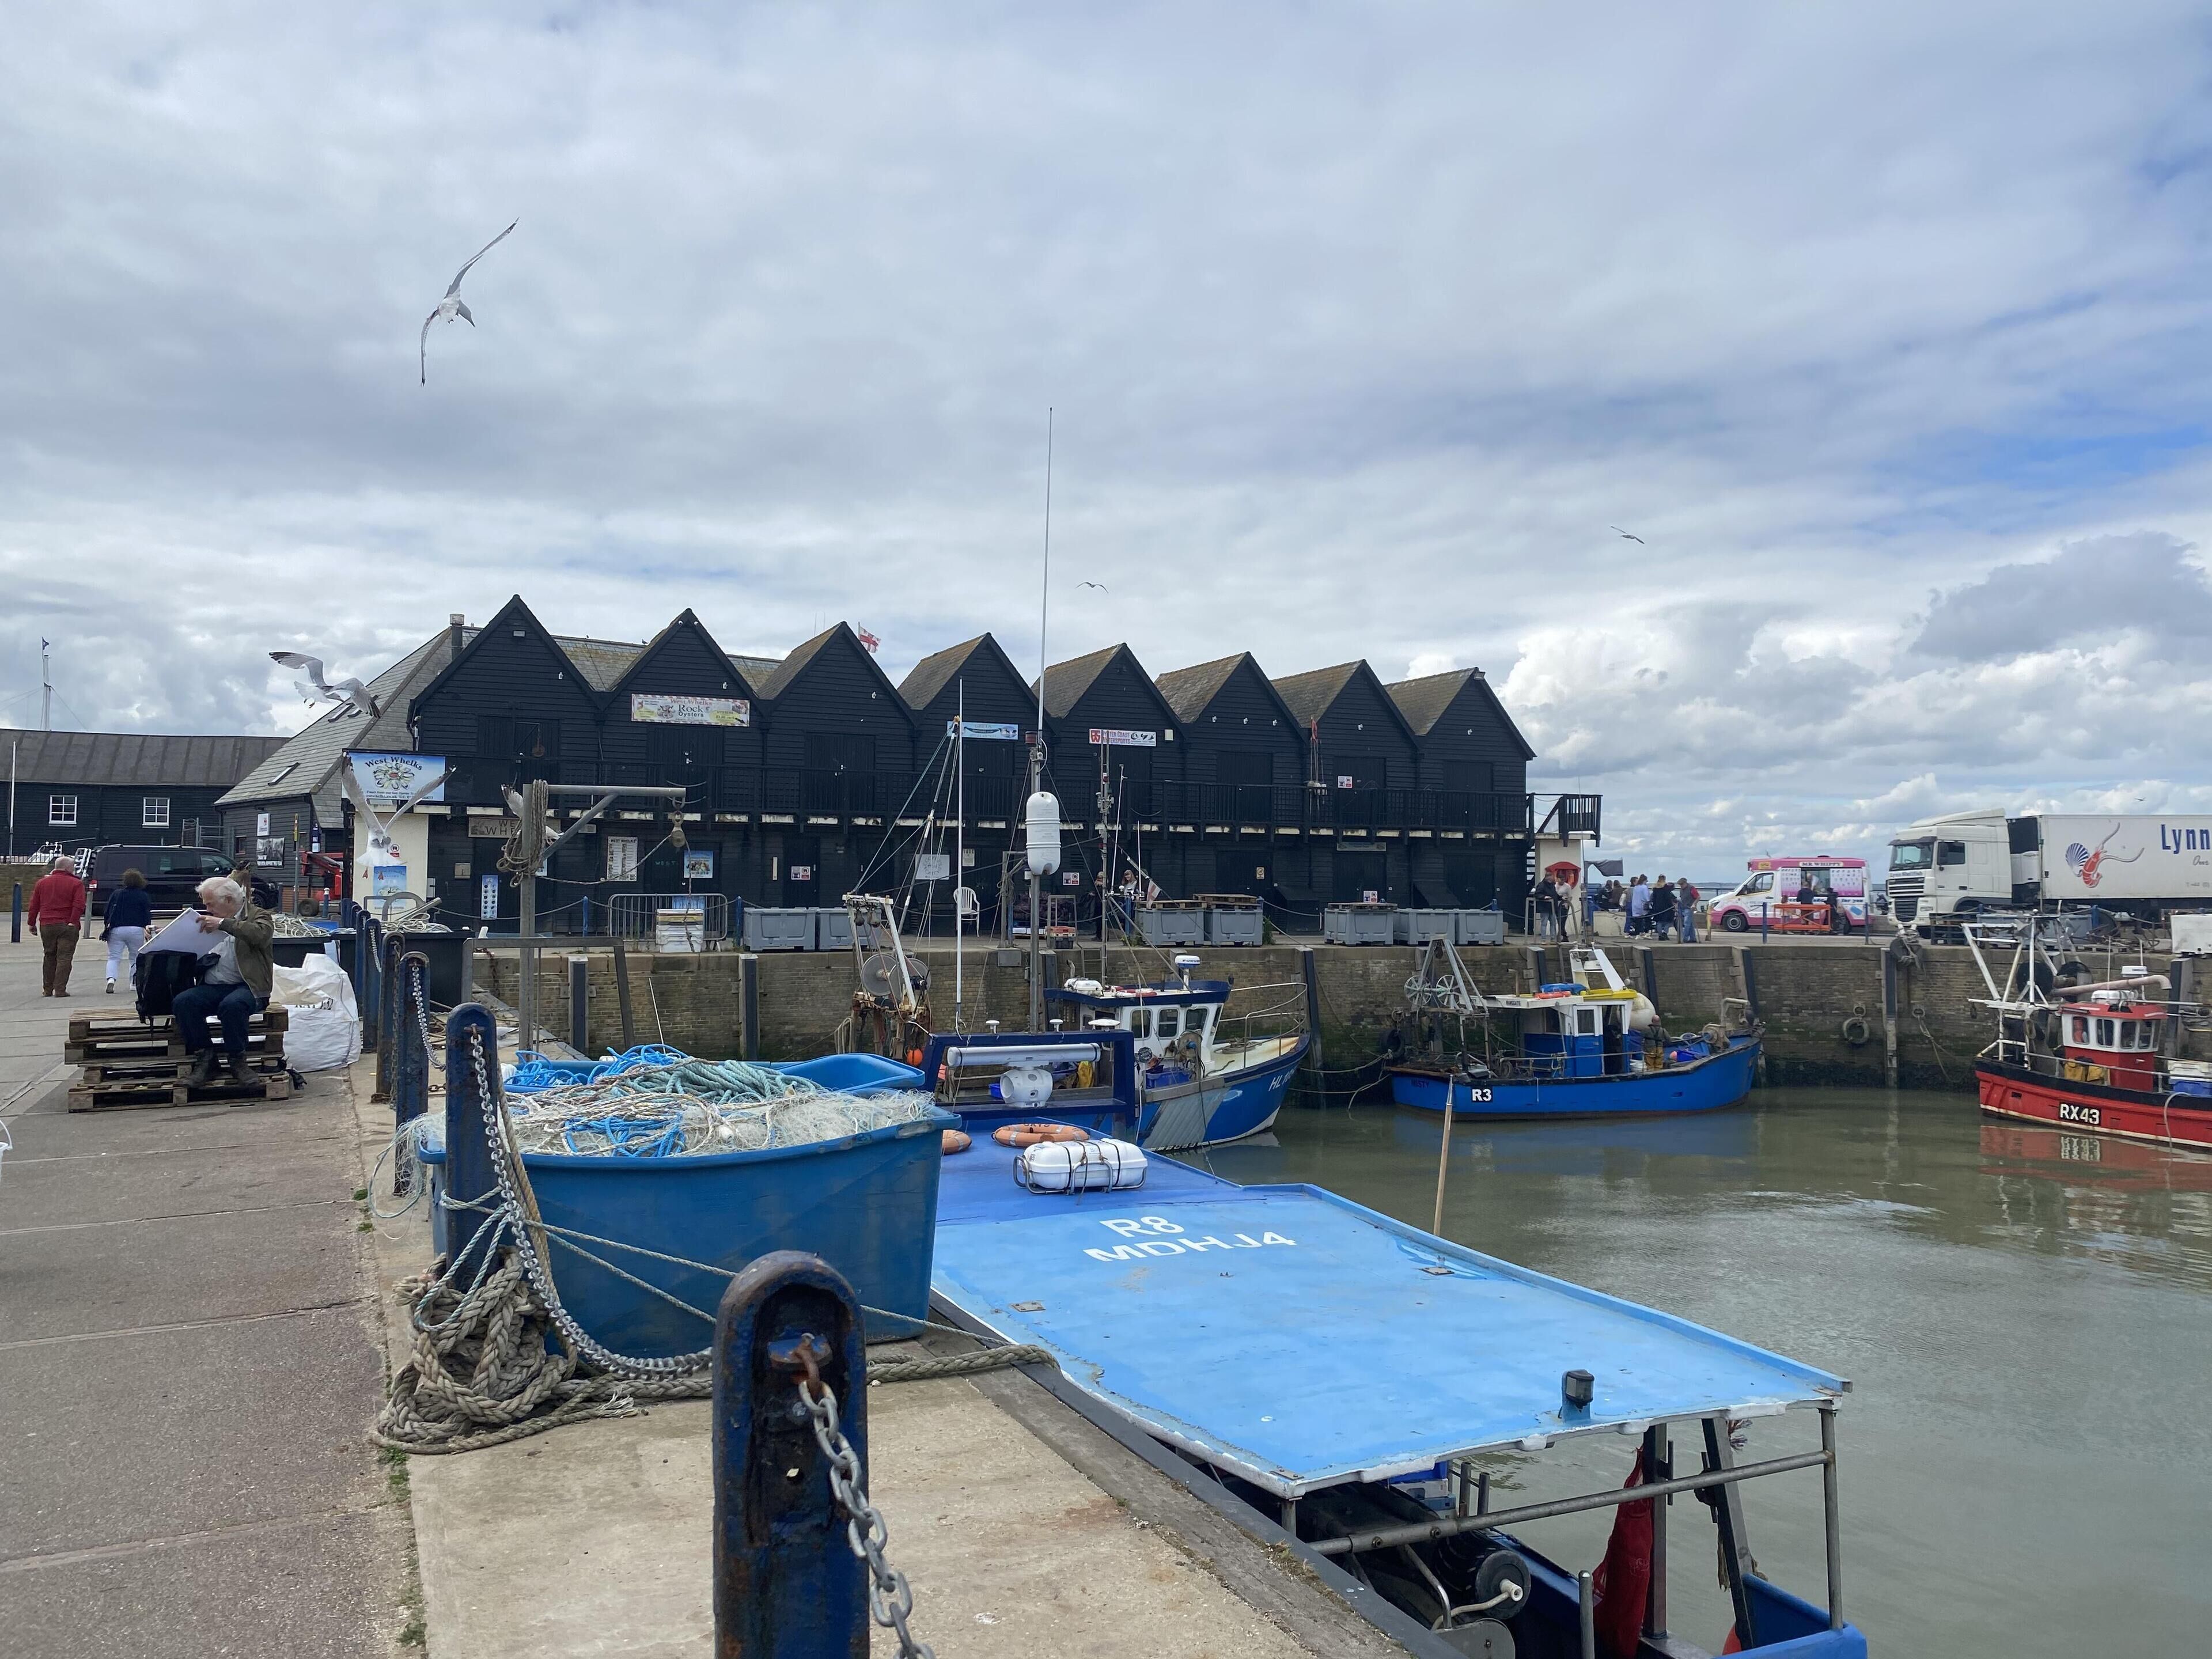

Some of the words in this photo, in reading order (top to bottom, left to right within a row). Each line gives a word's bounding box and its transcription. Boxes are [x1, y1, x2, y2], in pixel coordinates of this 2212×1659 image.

[678, 704, 703, 713] Rock
[365, 757, 387, 768] West
[391, 756, 423, 771] Whelks
[2161, 824, 2210, 854] Lynn
[1472, 1088, 1492, 1101] R3
[2060, 1103, 2100, 1124] RX43
[1099, 1216, 1185, 1238] R8
[1083, 1231, 1297, 1262] MDHJ4
